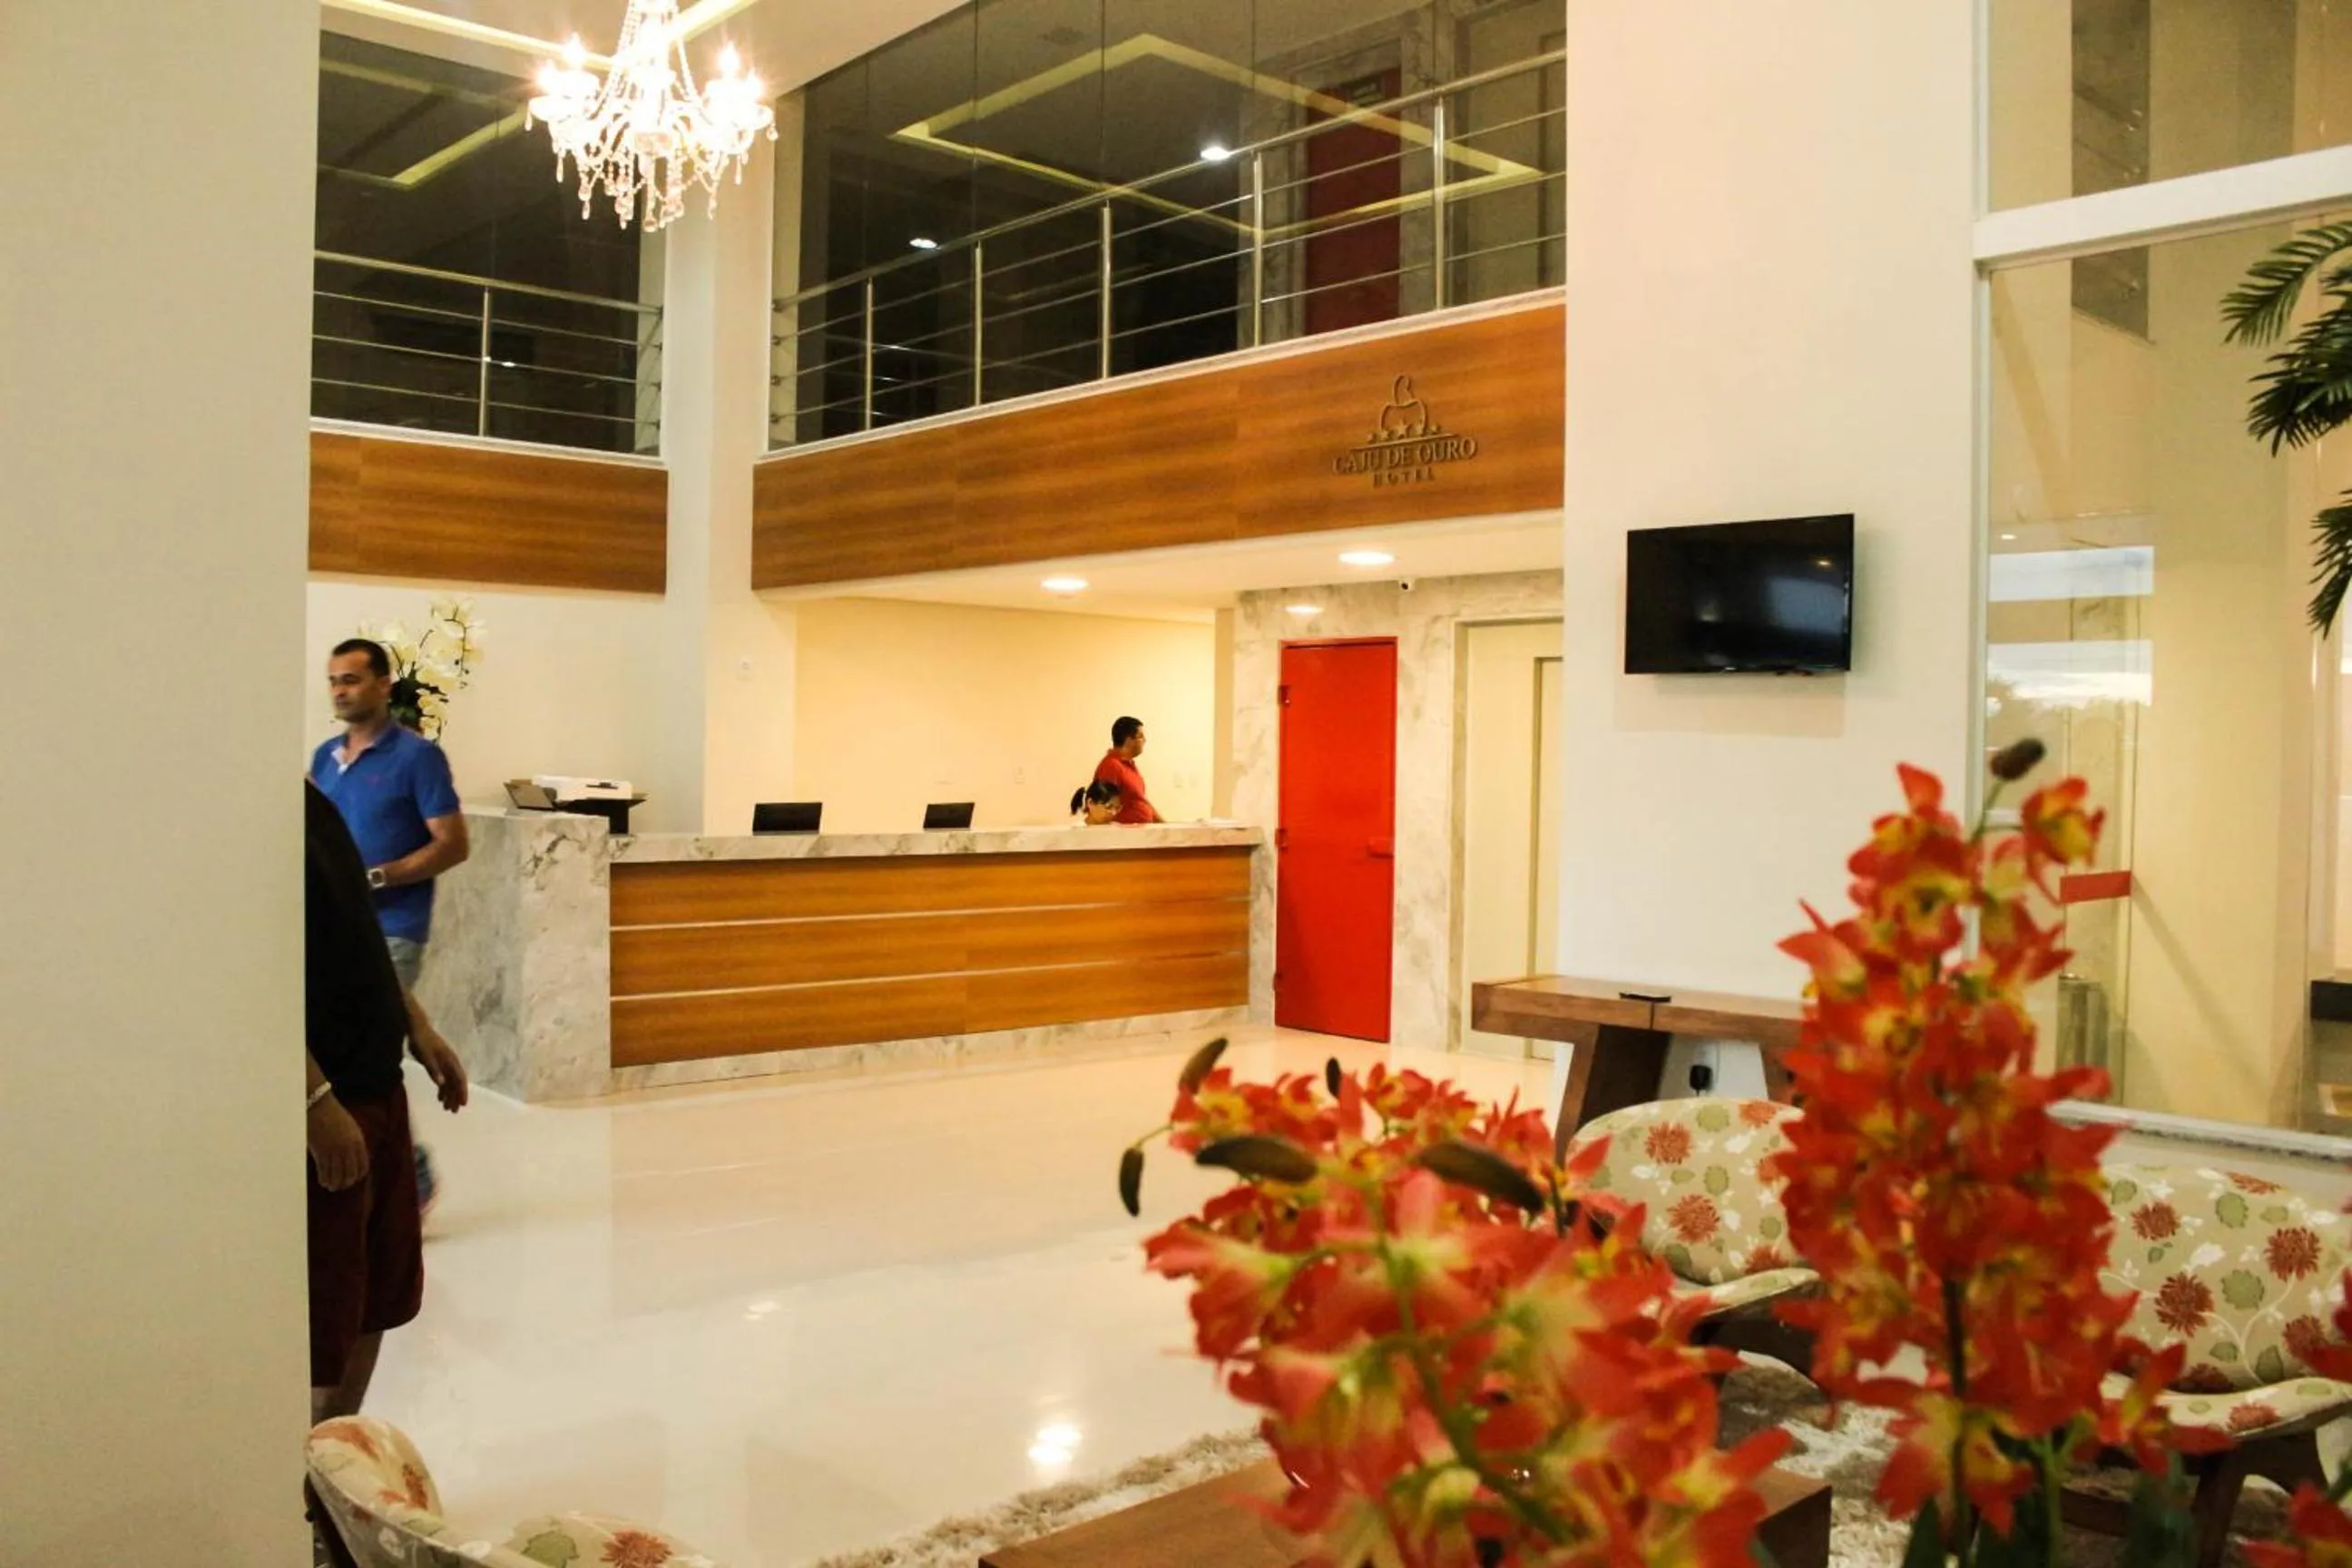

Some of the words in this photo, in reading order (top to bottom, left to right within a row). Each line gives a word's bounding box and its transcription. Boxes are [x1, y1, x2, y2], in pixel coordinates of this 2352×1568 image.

[1332, 449, 1380, 475] CAJU
[1387, 446, 1413, 468] DE
[1418, 437, 1478, 464] OURO
[1373, 466, 1435, 488] HOTEL
